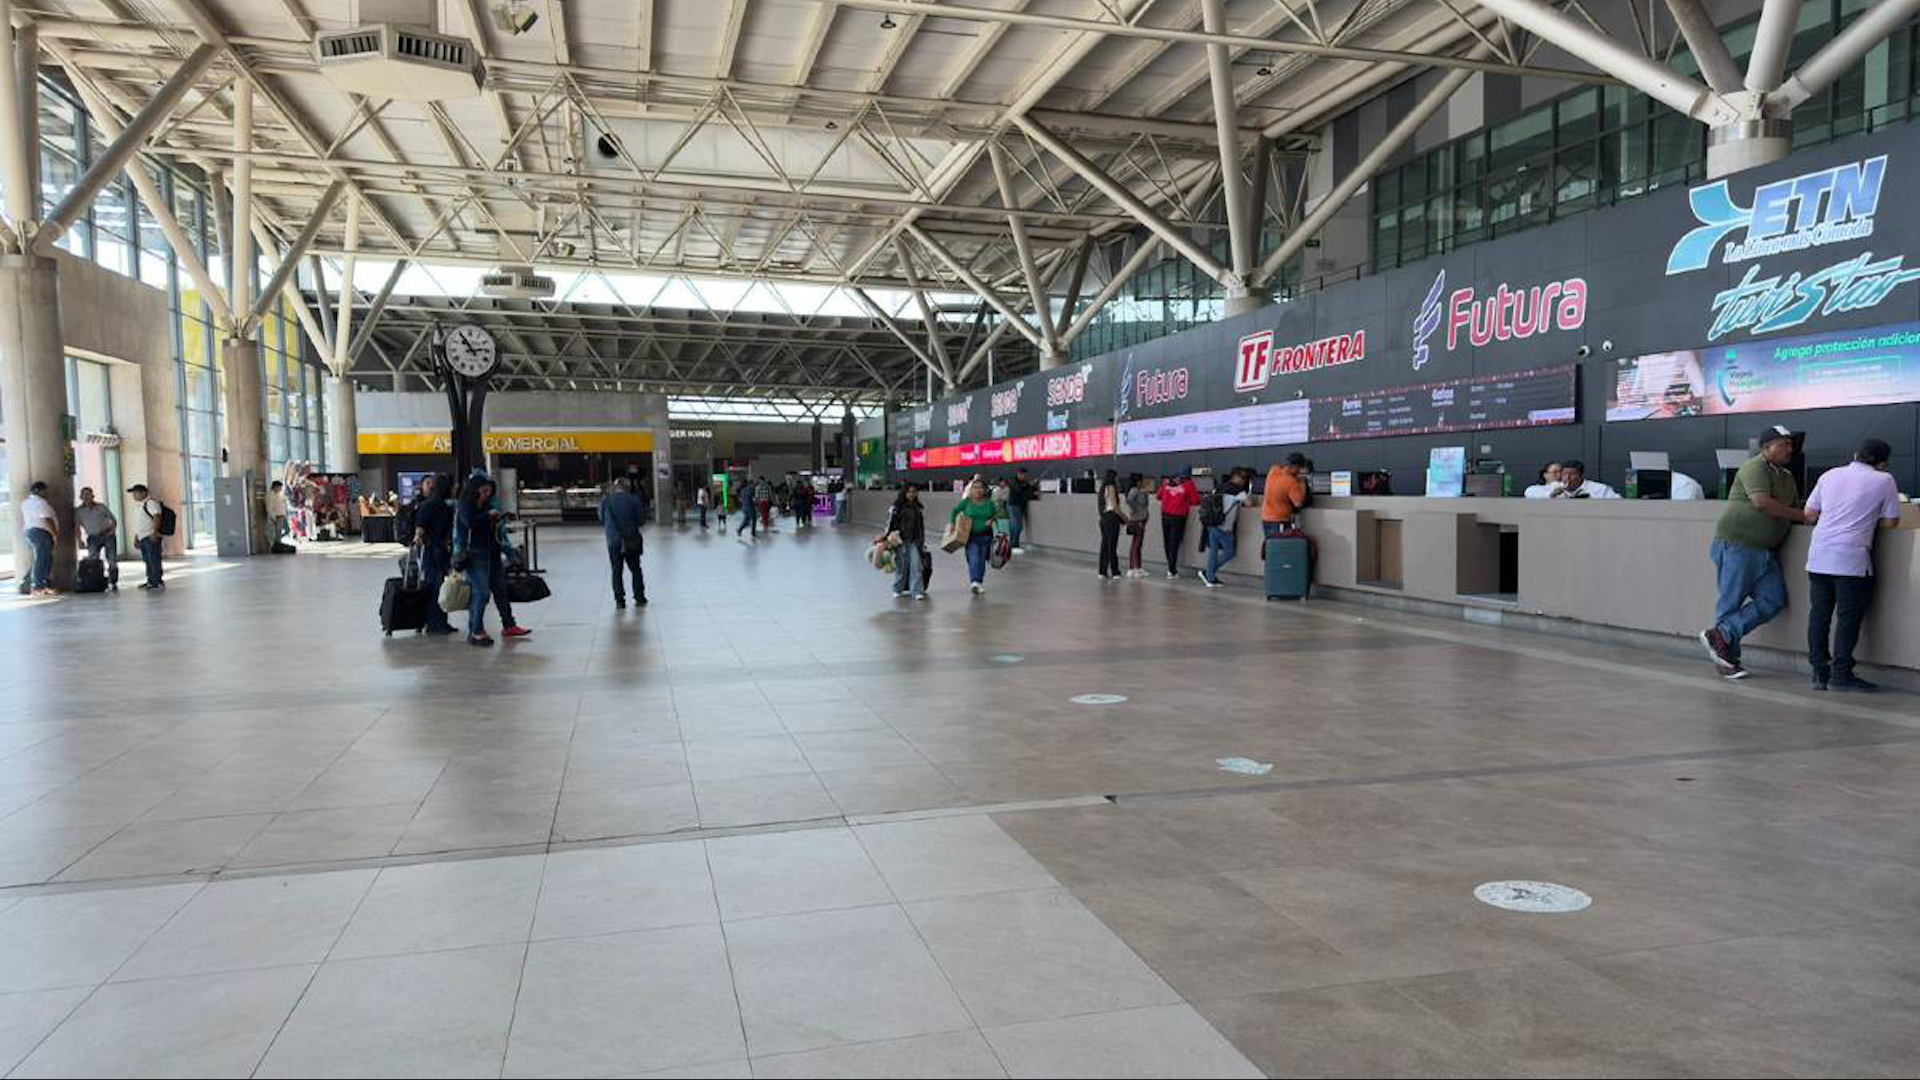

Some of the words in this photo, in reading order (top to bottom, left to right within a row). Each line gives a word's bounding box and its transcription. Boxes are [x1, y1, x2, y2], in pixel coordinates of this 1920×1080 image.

[1748, 154, 1888, 238] ETN
[1447, 278, 1587, 350] Futura
[1240, 337, 1270, 386] TF
[1271, 330, 1364, 376] FRONTERA
[1136, 367, 1188, 408] Futura
[484, 436, 579, 450] COMERCIAL
